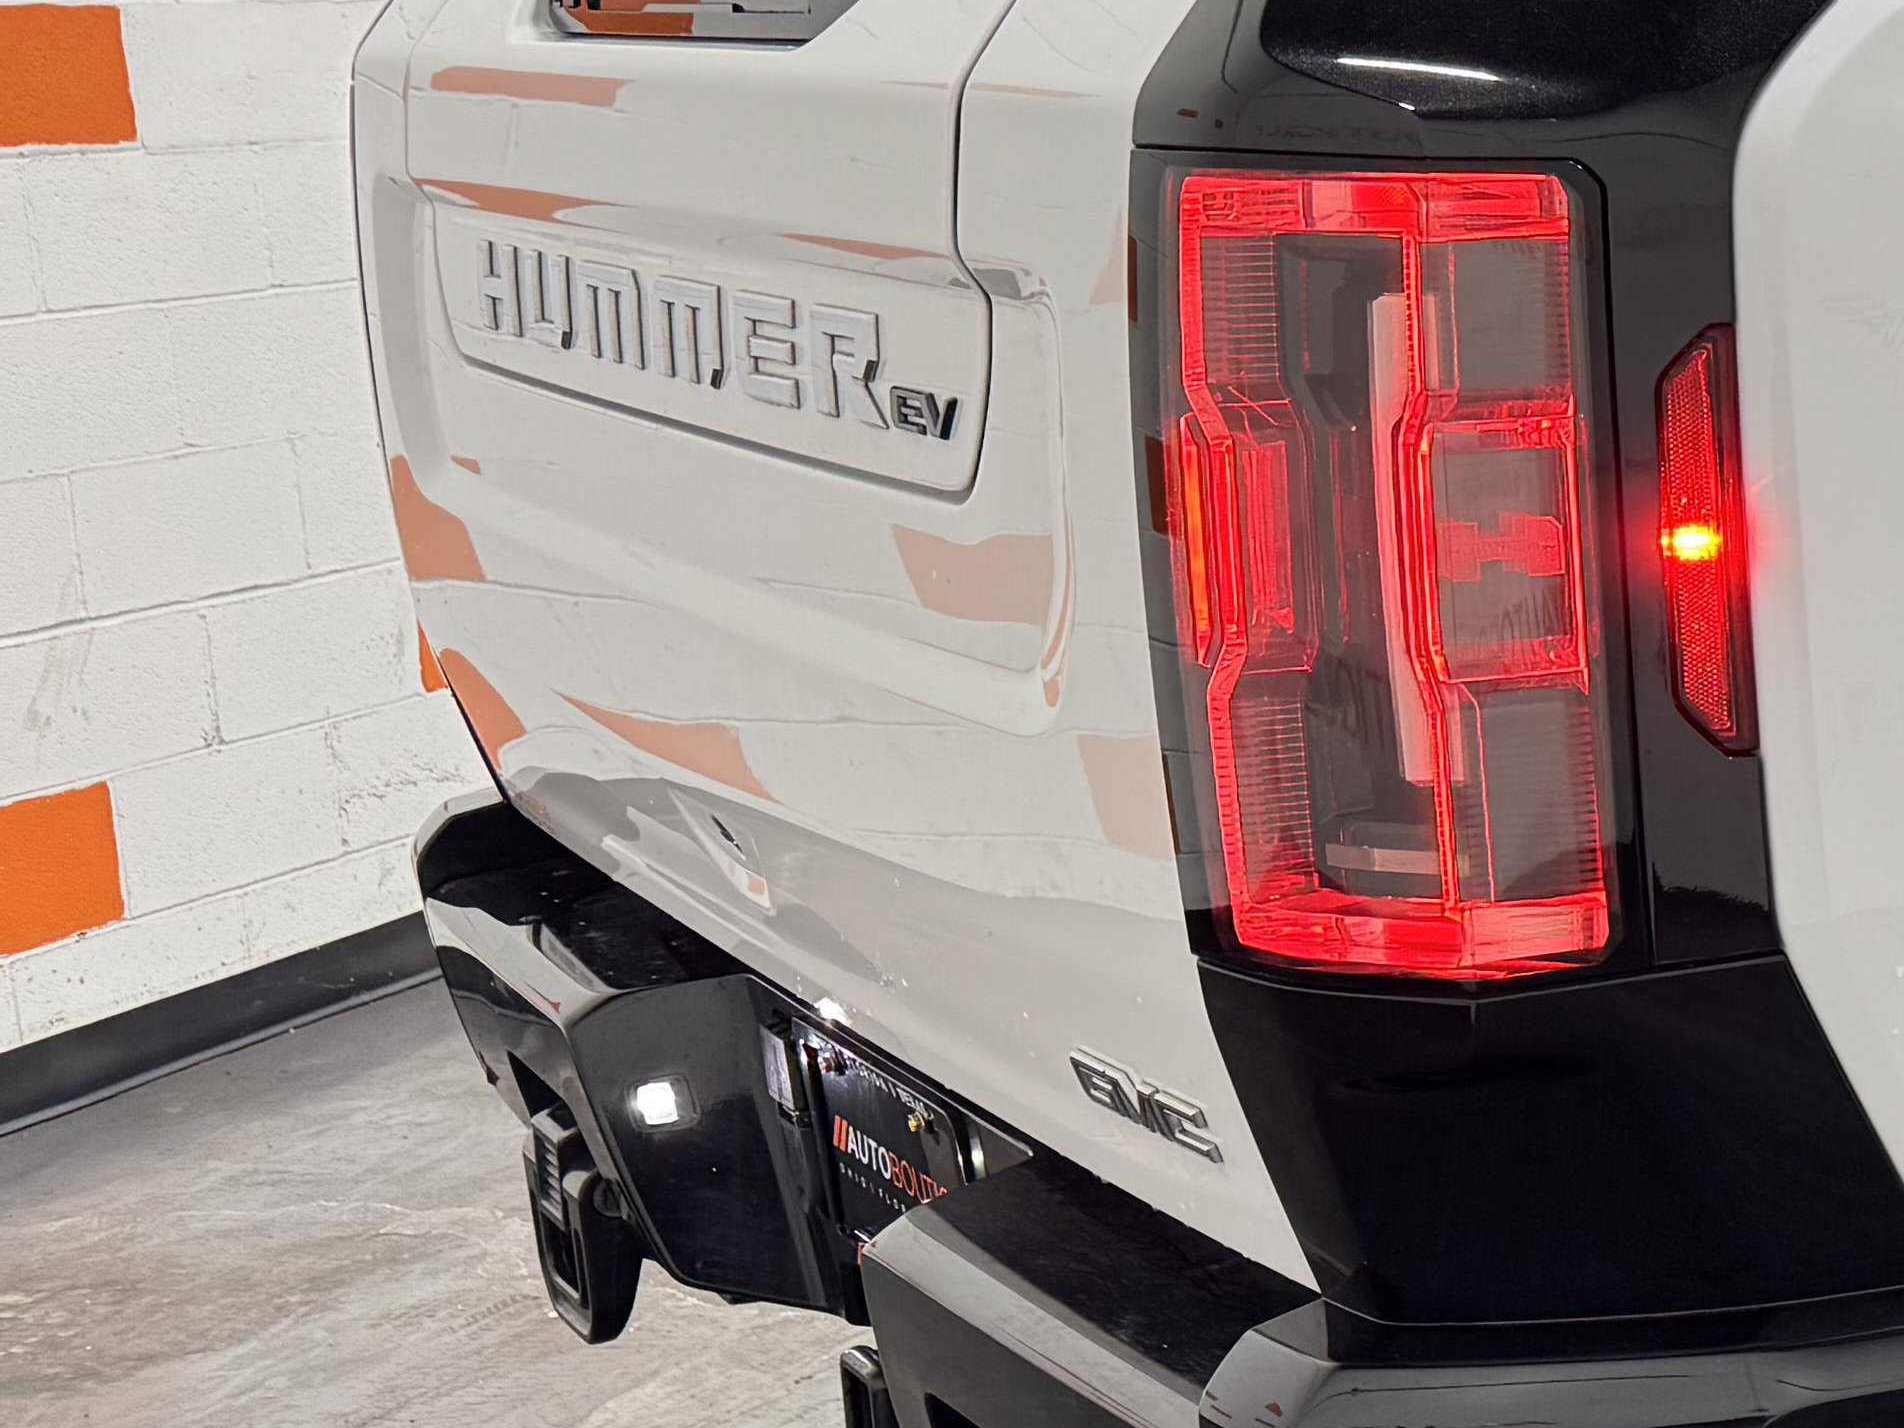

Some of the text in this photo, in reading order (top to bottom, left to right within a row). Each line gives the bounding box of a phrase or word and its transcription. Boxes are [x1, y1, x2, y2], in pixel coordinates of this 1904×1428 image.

[478, 239, 960, 441] HUMMER EV
[848, 1125, 948, 1204] AUTOBOUTI
